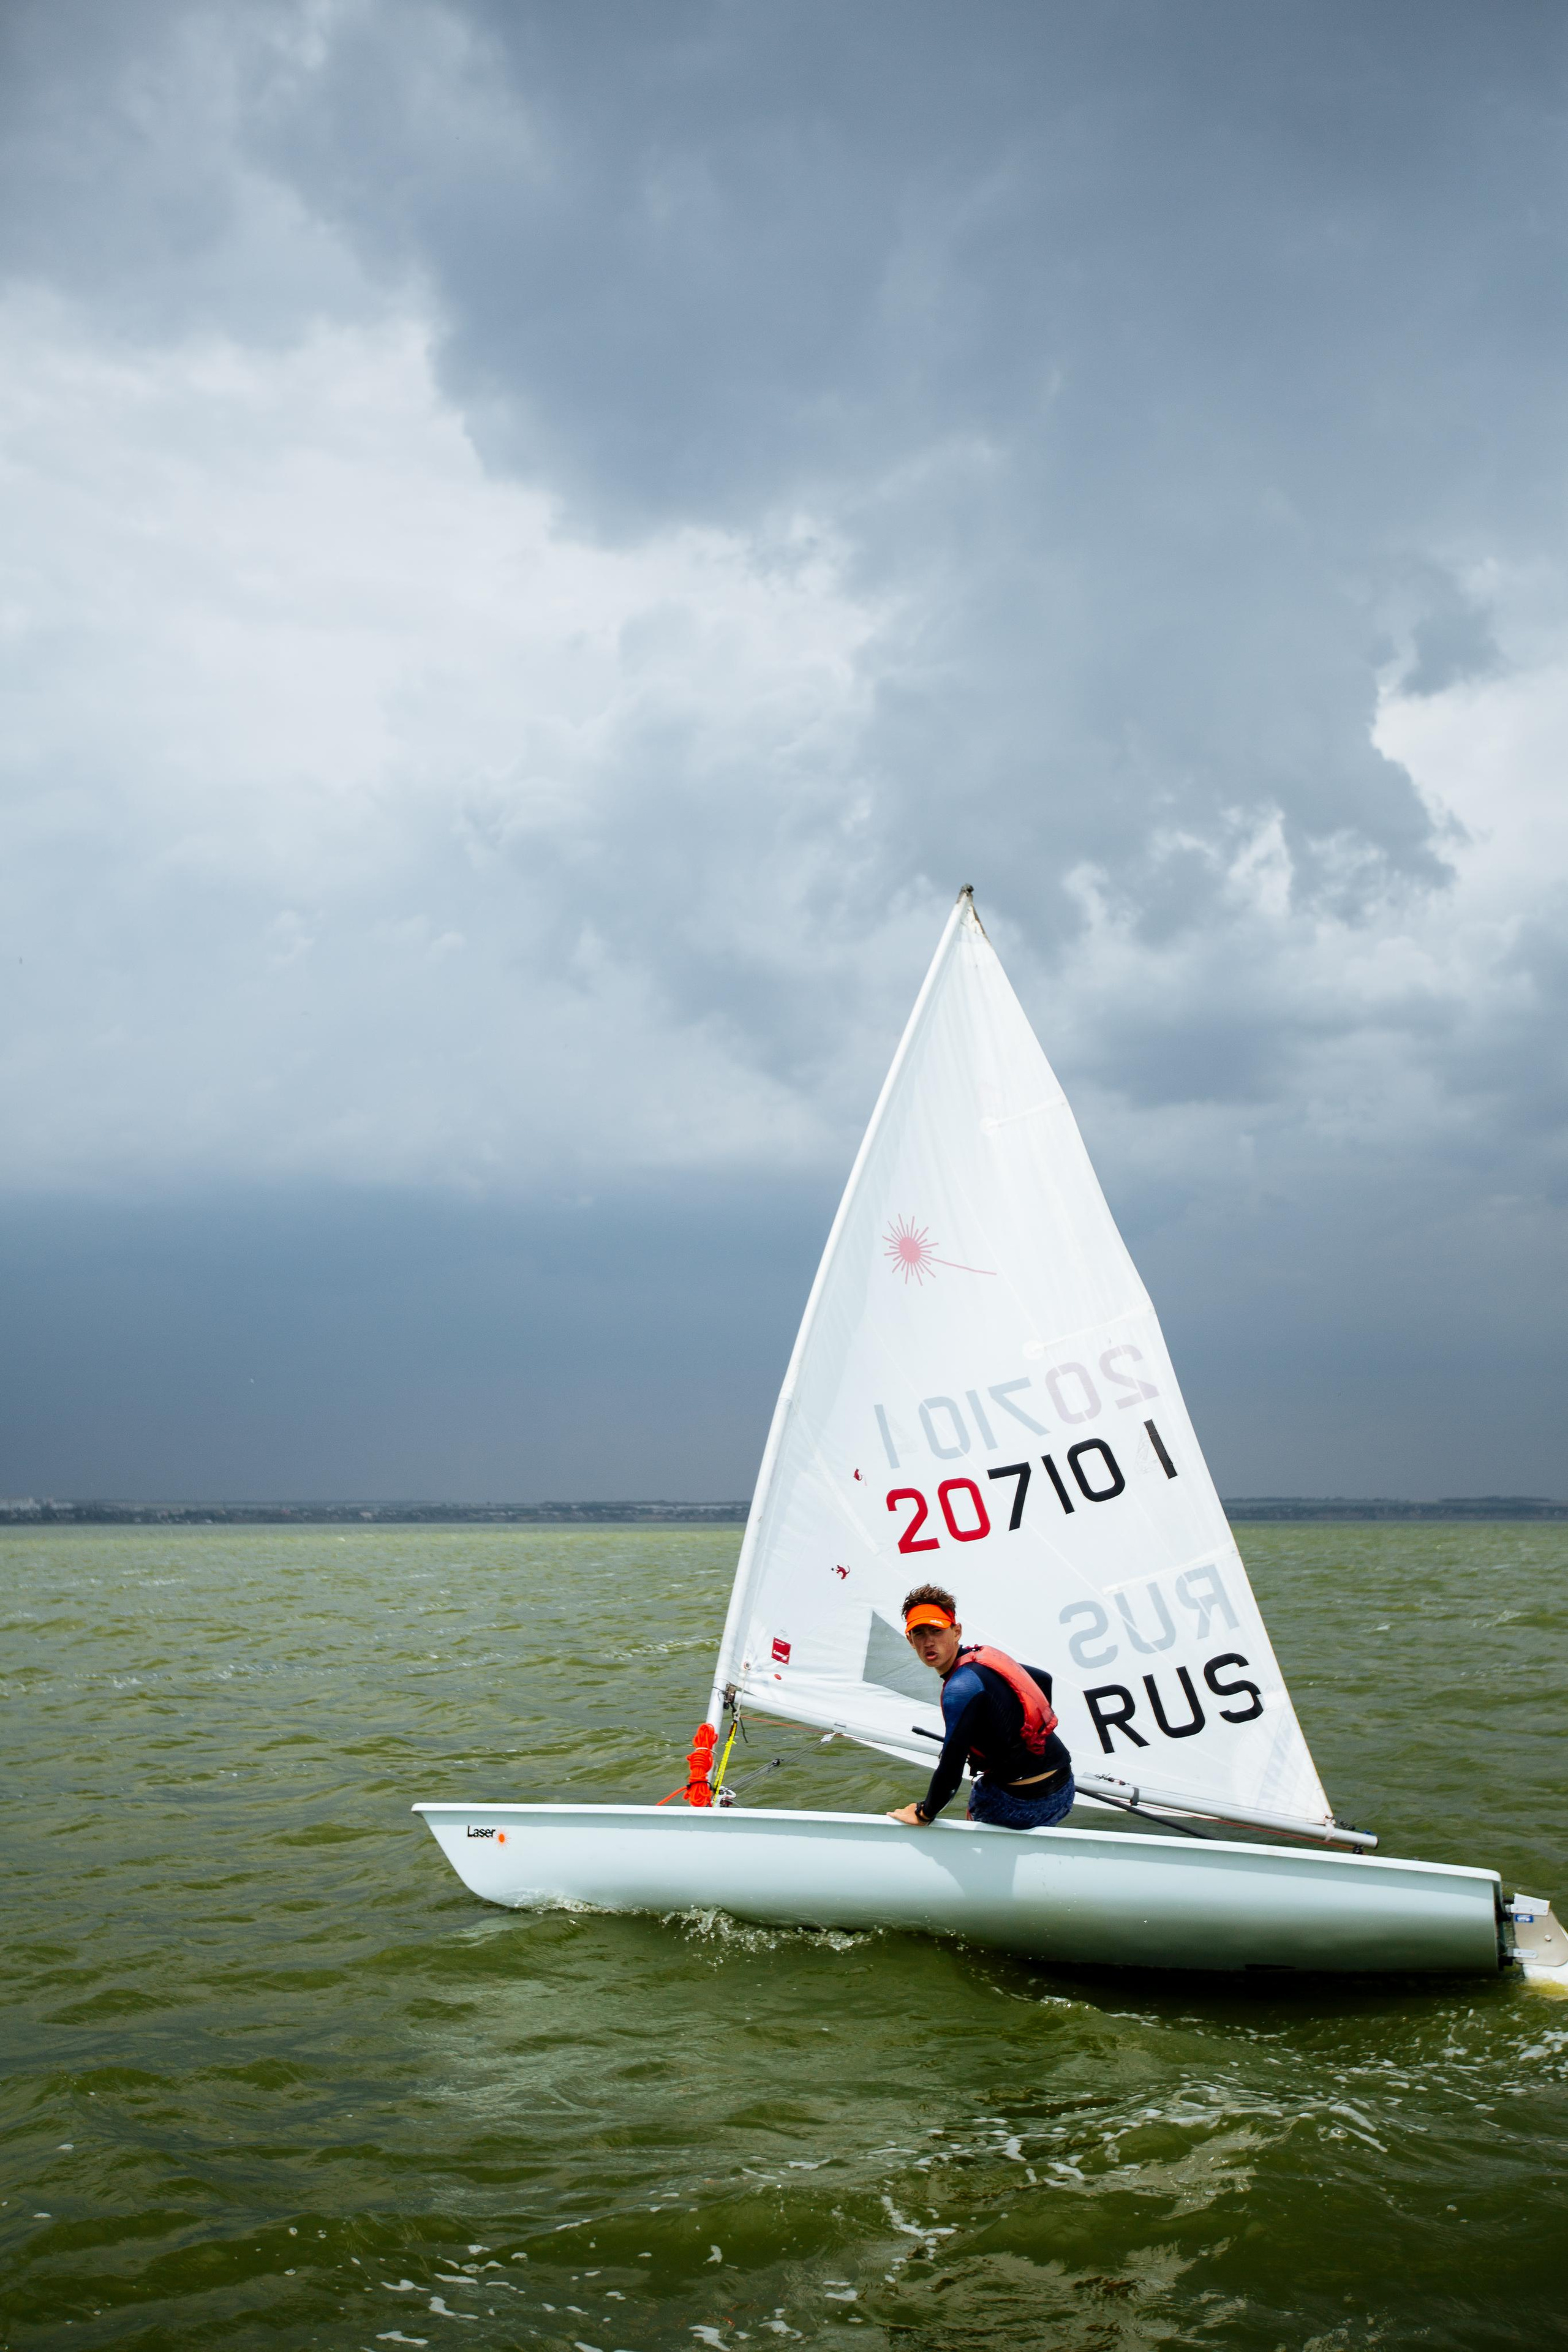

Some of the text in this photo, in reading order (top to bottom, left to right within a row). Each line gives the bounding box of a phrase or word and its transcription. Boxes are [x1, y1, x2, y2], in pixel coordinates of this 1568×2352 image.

[886, 1418, 1178, 1555] 207101
[1082, 1653, 1264, 1754] RUS
[467, 1825, 496, 1838] Laser
